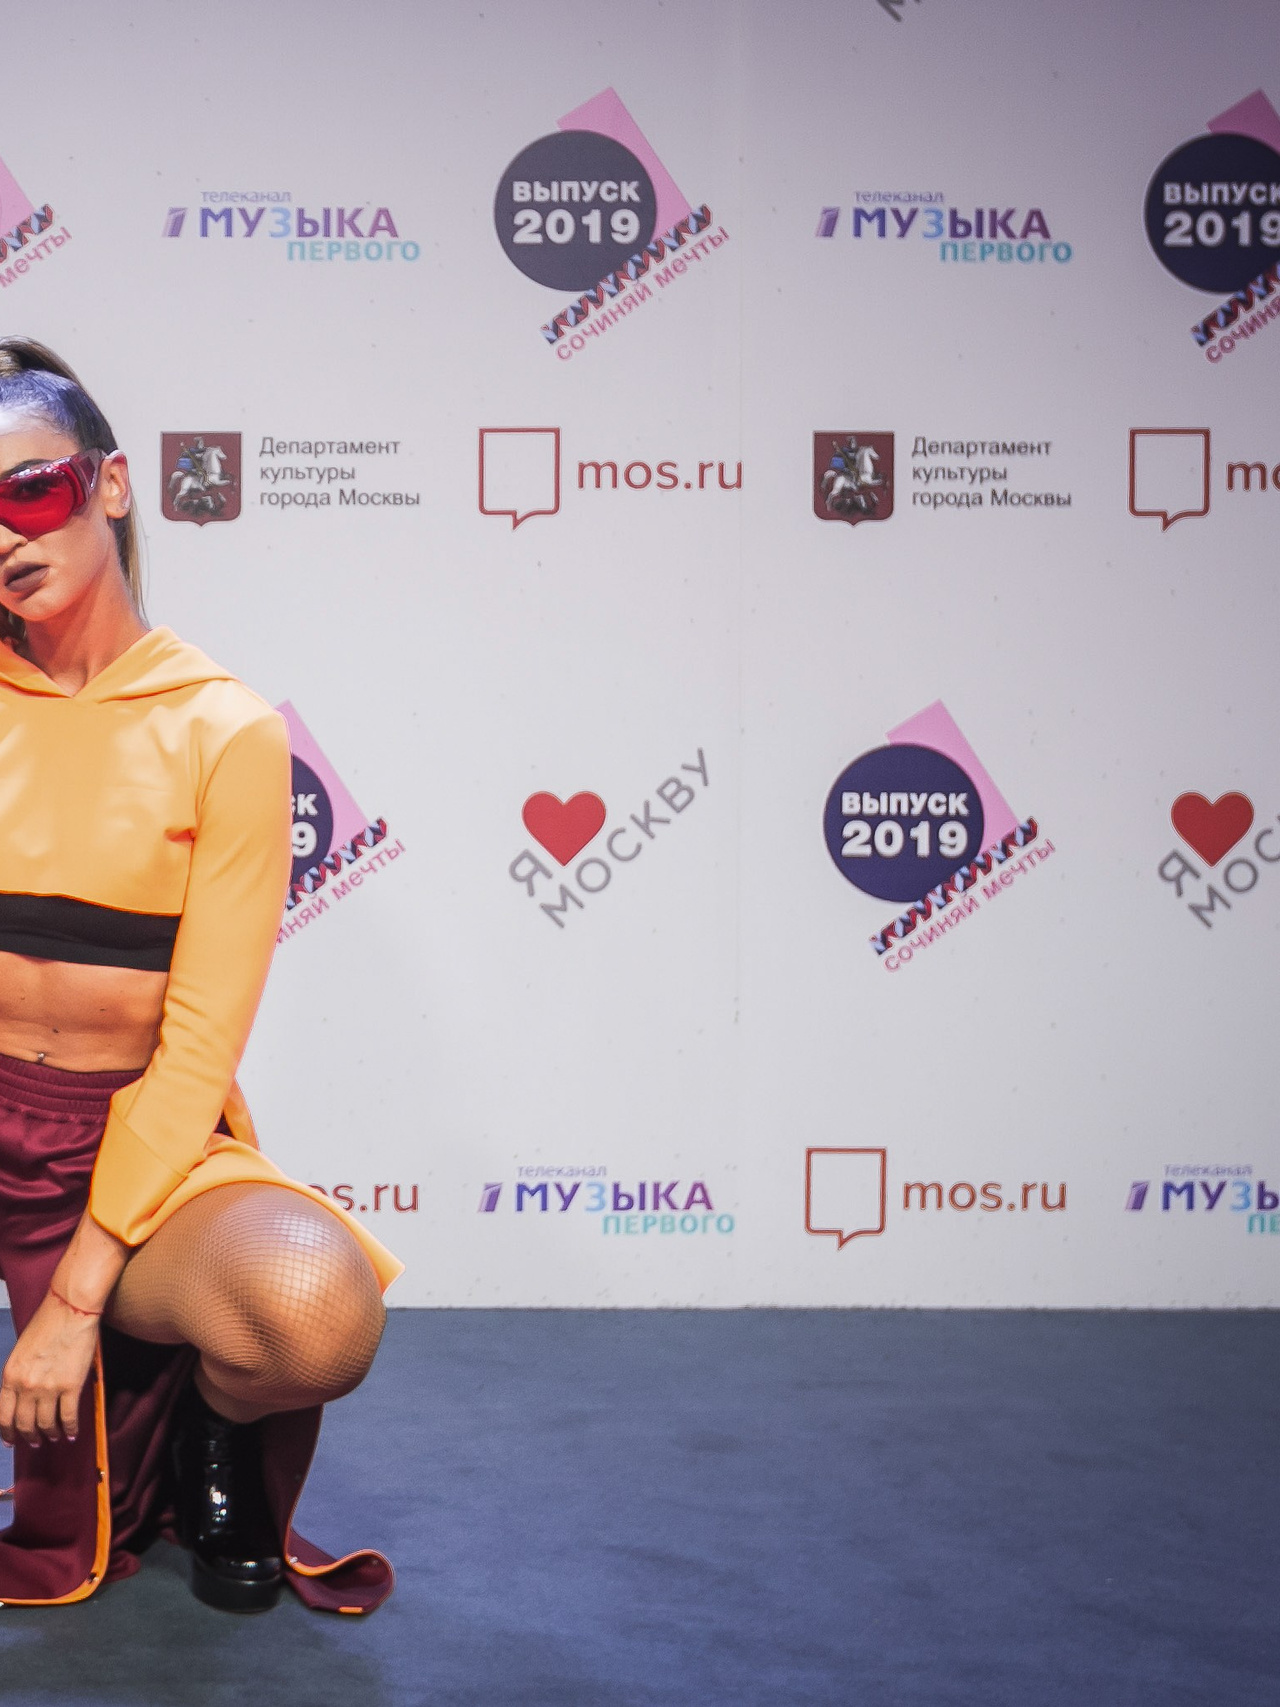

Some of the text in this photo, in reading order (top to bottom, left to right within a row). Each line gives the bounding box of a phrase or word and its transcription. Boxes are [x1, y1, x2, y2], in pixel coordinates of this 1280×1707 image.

[201, 191, 291, 203] телеканал
[513, 181, 640, 202] ВЫПУСК
[856, 192, 944, 204] телеканал
[200, 207, 399, 238] МУЗЫКА
[513, 209, 639, 244] 2019
[854, 208, 1051, 240] МУЗЫКА
[1164, 211, 1280, 246] 2019
[288, 240, 421, 261] ПЕРВОГО
[941, 242, 1073, 263] ПЕРВОГО
[259, 437, 400, 458] Департамент
[912, 437, 1051, 458] Департамент
[260, 467, 355, 484] культуры
[578, 461, 742, 489] mos.ru
[913, 467, 1007, 485] культуры
[260, 488, 420, 509] города Москвы
[913, 488, 1071, 510] города Москвы
[842, 792, 968, 816] ВЫПУСК
[540, 748, 710, 928] МОСКВУ
[842, 820, 967, 857] 2019
[509, 850, 553, 897] Я
[1158, 850, 1201, 898] Я
[1188, 822, 1280, 929] МОС
[518, 1166, 607, 1178] телеканал
[308, 1184, 418, 1212] s.ru
[516, 1182, 713, 1212] МУЗЫКА
[903, 1182, 1066, 1212] mos.ru
[1162, 1181, 1280, 1211] МУЗЫ
[603, 1215, 735, 1236] ПЕРВОГО
